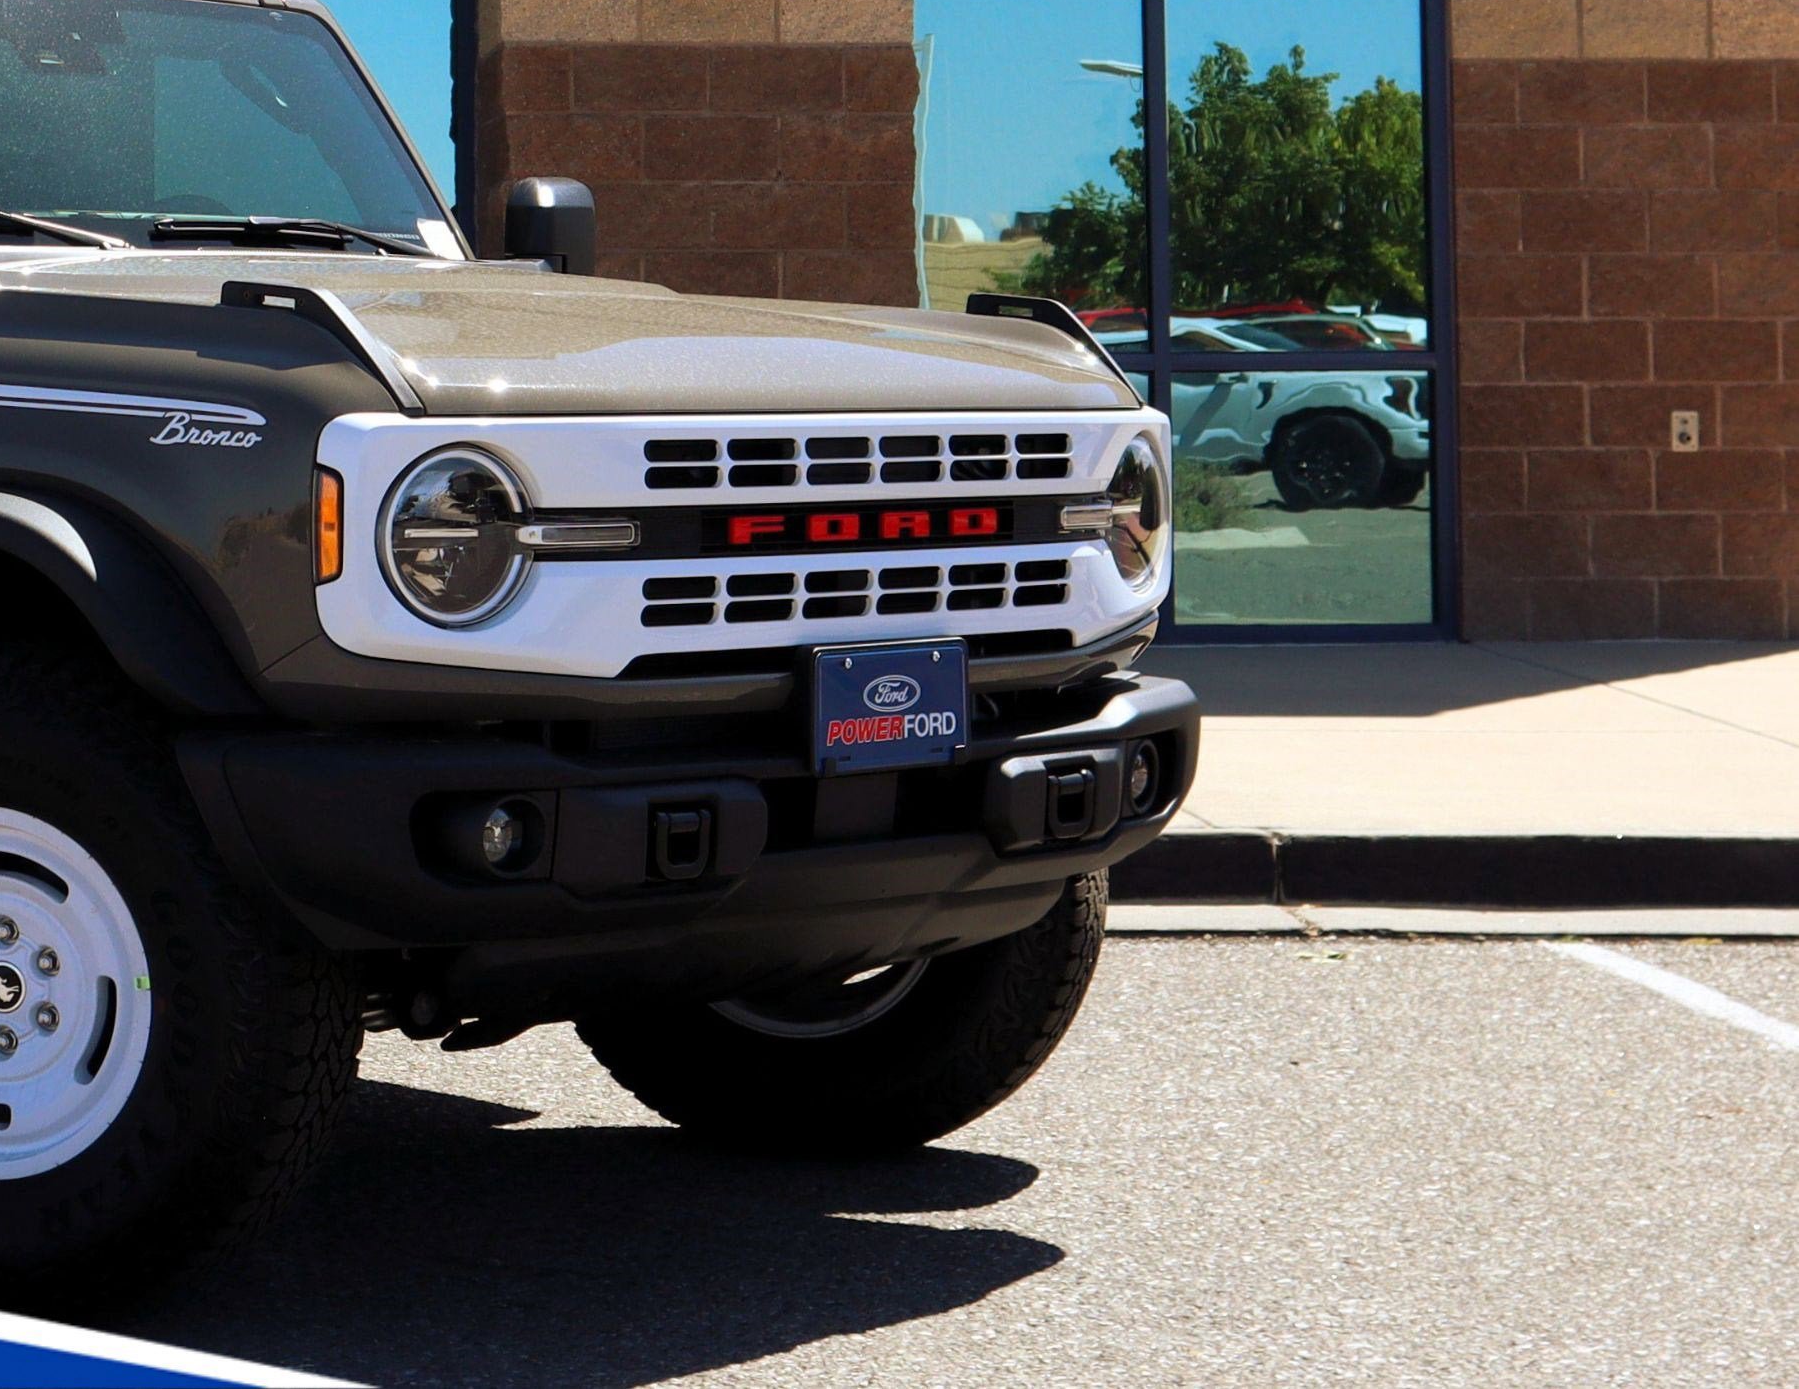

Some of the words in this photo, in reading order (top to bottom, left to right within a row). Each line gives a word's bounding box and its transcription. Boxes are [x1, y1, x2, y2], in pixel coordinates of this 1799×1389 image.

[149, 411, 263, 449] Bronco
[728, 507, 998, 545] FORD
[873, 680, 910, 705] Ford
